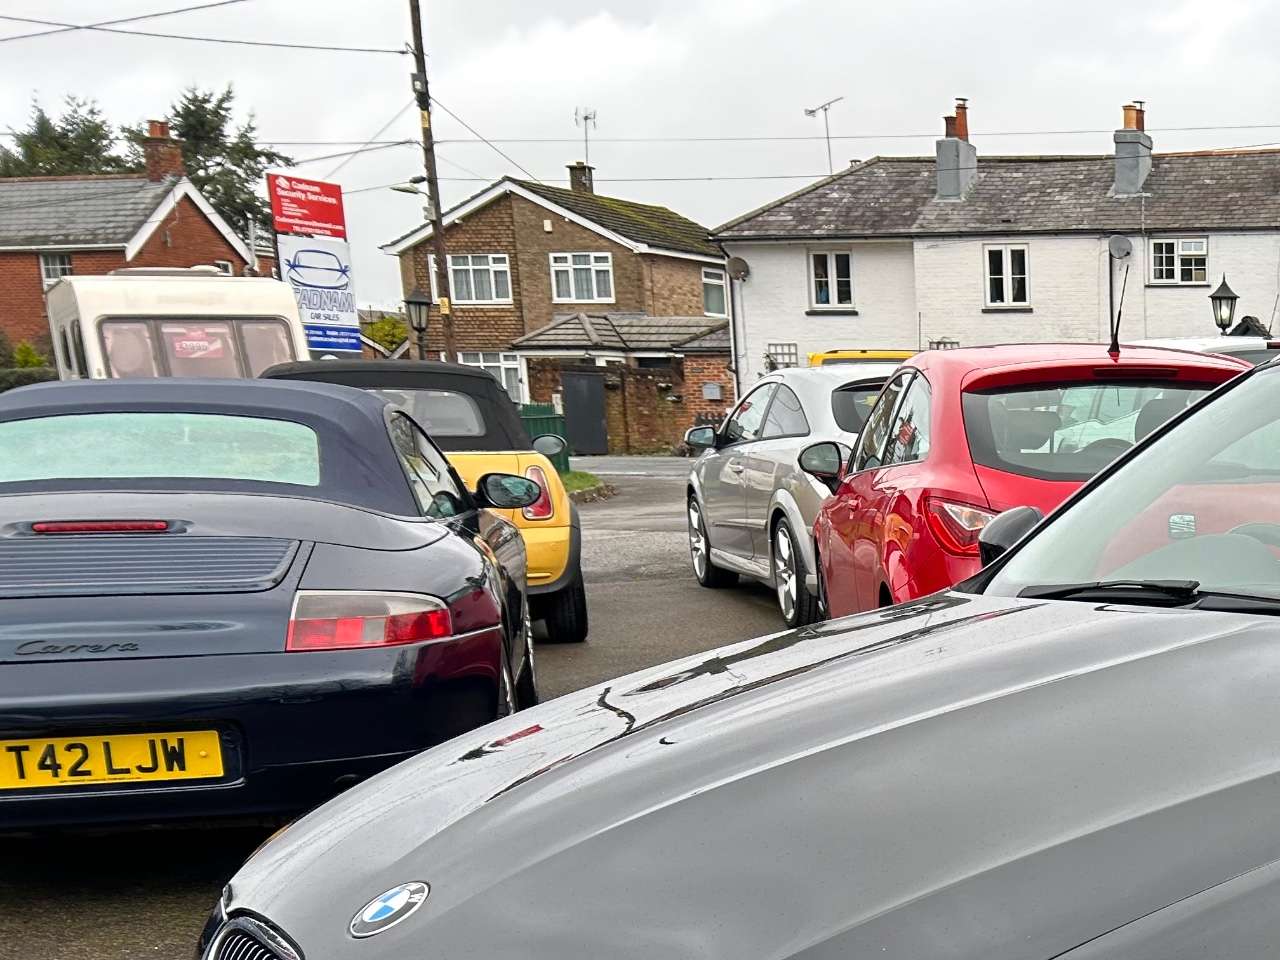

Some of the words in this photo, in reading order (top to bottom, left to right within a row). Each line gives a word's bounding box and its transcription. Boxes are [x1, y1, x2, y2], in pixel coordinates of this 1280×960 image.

[276, 187, 306, 200] Security
[307, 192, 337, 204] Services
[14, 639, 139, 656] Carrera
[5, 743, 92, 780] T42
[102, 737, 187, 775] LJW
